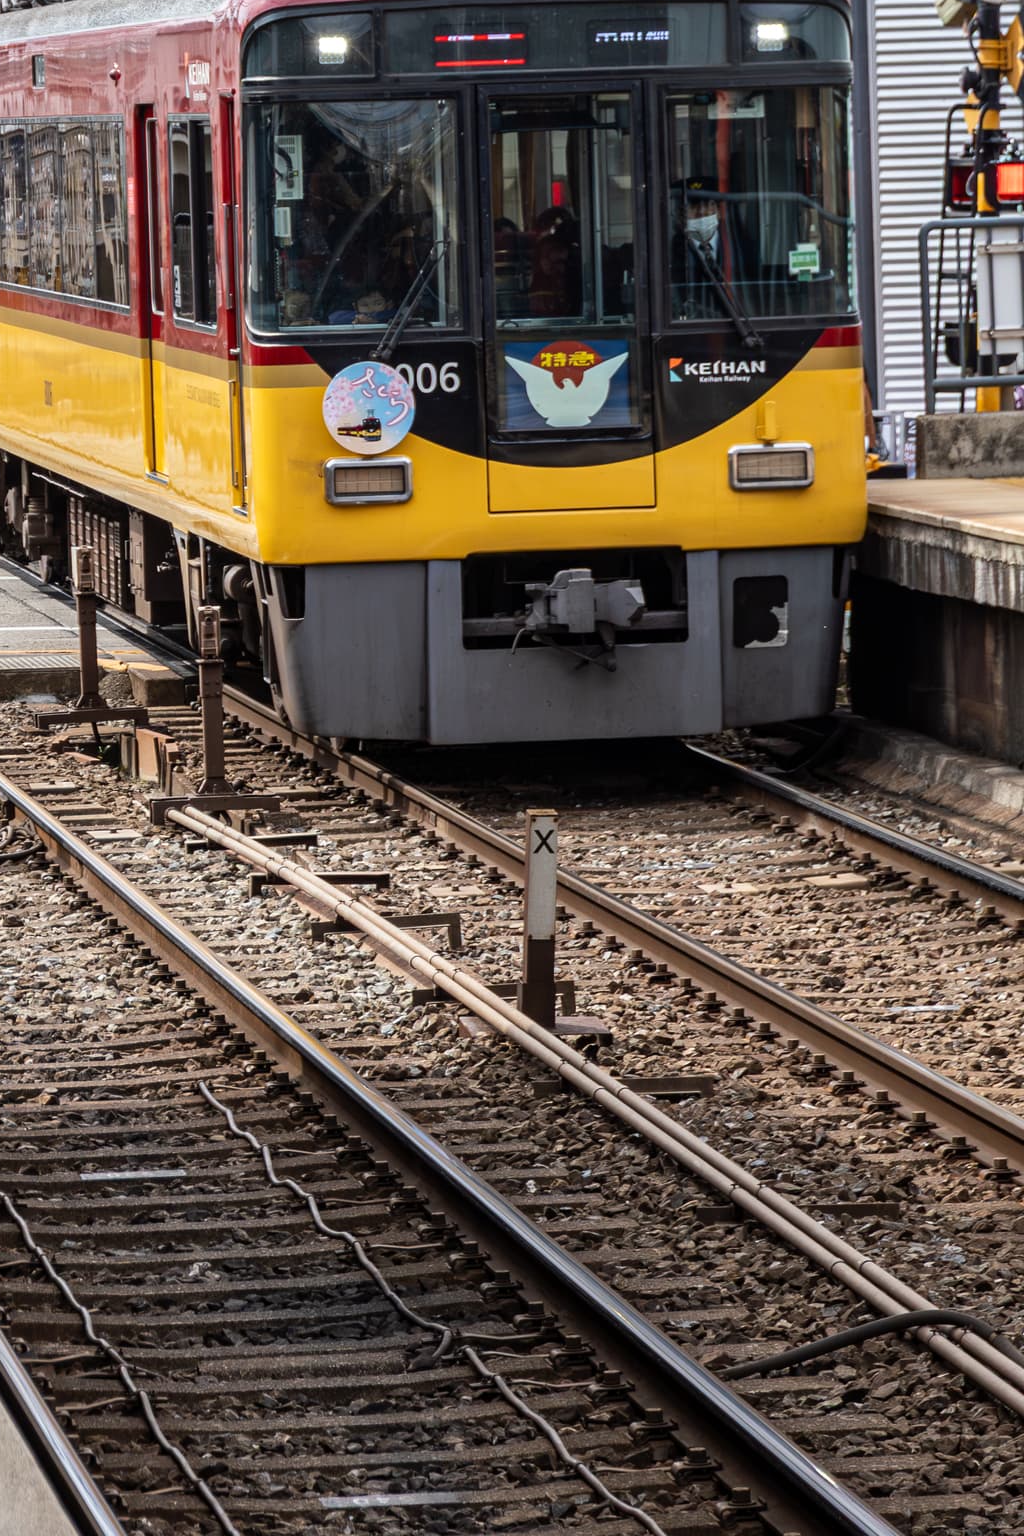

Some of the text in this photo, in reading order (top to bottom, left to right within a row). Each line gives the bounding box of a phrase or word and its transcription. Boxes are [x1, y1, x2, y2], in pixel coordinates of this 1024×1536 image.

[540, 350, 595, 368] 特急
[684, 359, 767, 376] KEIHAN
[699, 375, 751, 383] Keihan Railway
[351, 367, 410, 427] さくら
[533, 830, 554, 854] X
